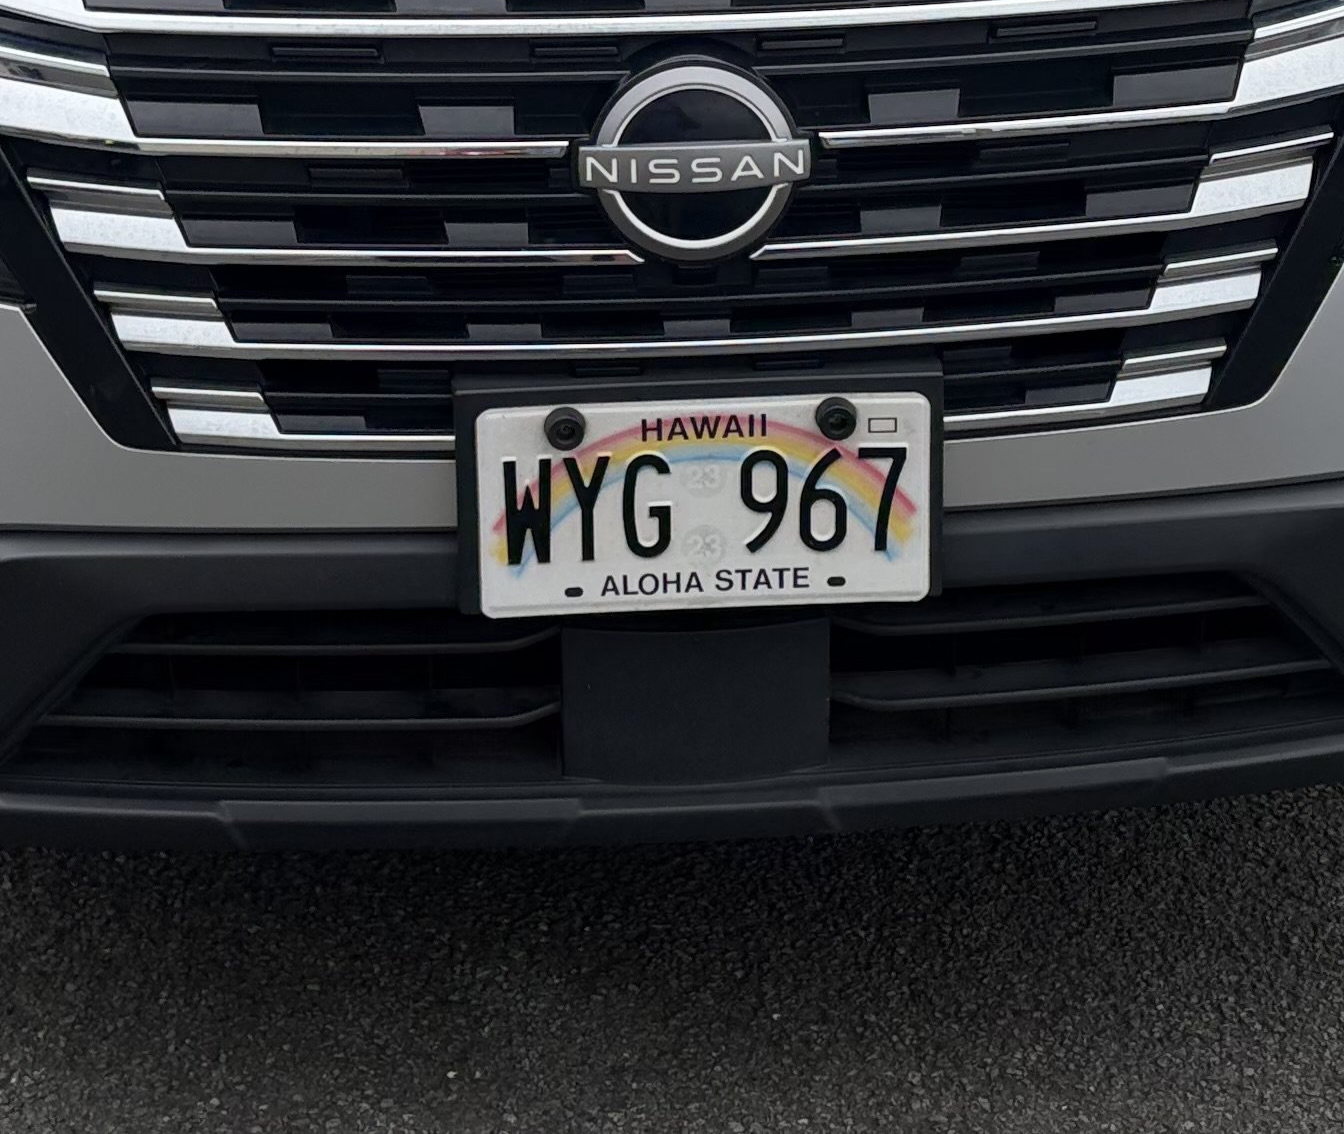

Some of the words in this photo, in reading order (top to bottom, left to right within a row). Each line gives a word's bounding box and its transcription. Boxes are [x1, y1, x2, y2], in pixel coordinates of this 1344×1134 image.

[585, 149, 805, 184] NISSAN
[640, 413, 768, 443] HAWAII
[502, 453, 672, 566] WYG
[740, 447, 908, 554] 967
[600, 571, 704, 597] ALOHA
[714, 566, 810, 592] STATE
